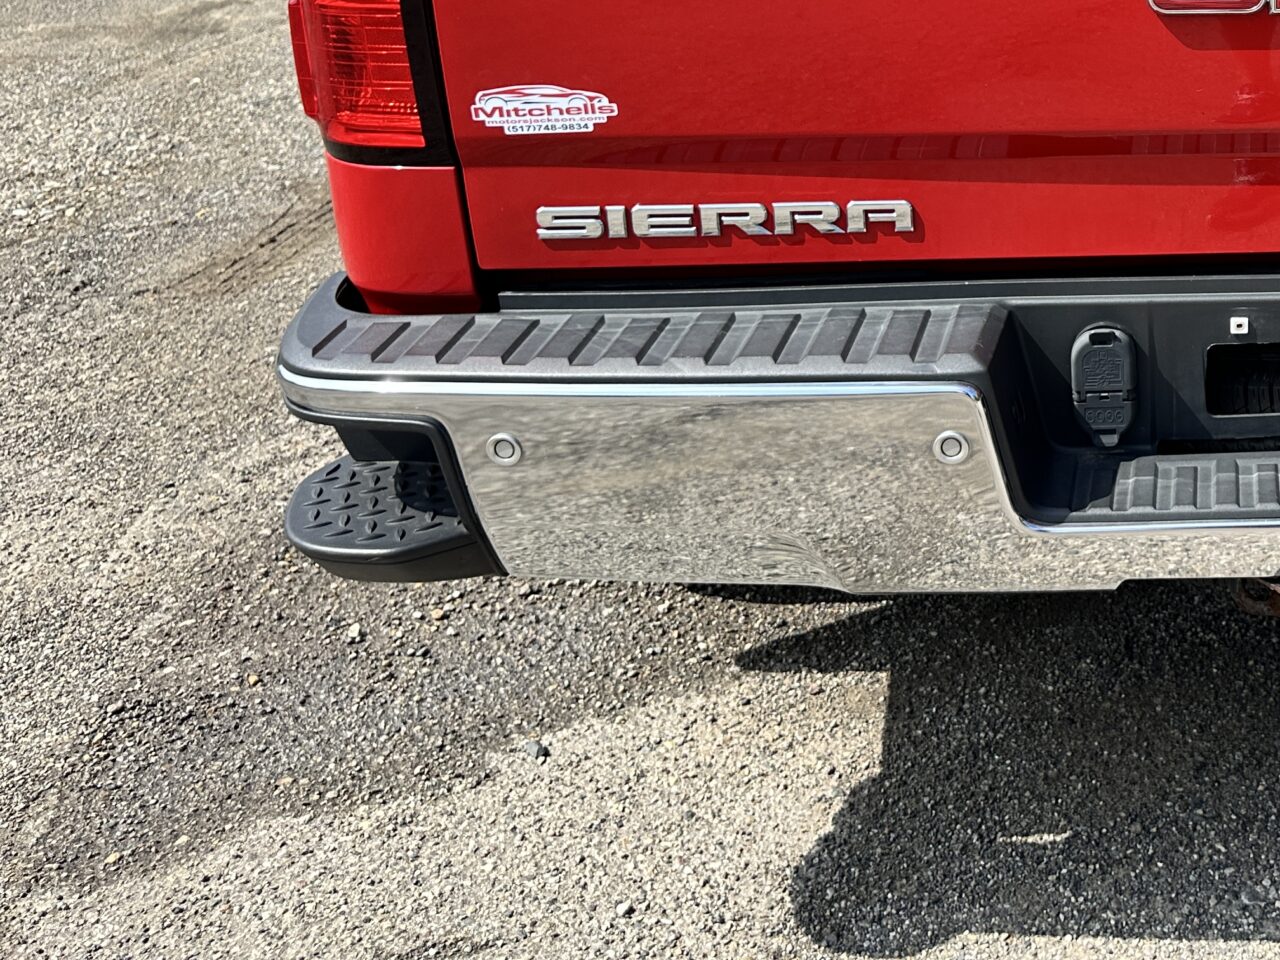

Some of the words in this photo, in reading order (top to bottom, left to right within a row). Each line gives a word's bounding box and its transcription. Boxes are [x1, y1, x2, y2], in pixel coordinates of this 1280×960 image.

[474, 103, 615, 118] Mitchells
[487, 116, 605, 125] motorsjackson.com
[507, 123, 590, 133] (517)748-9834
[536, 199, 915, 239] SIERRA
